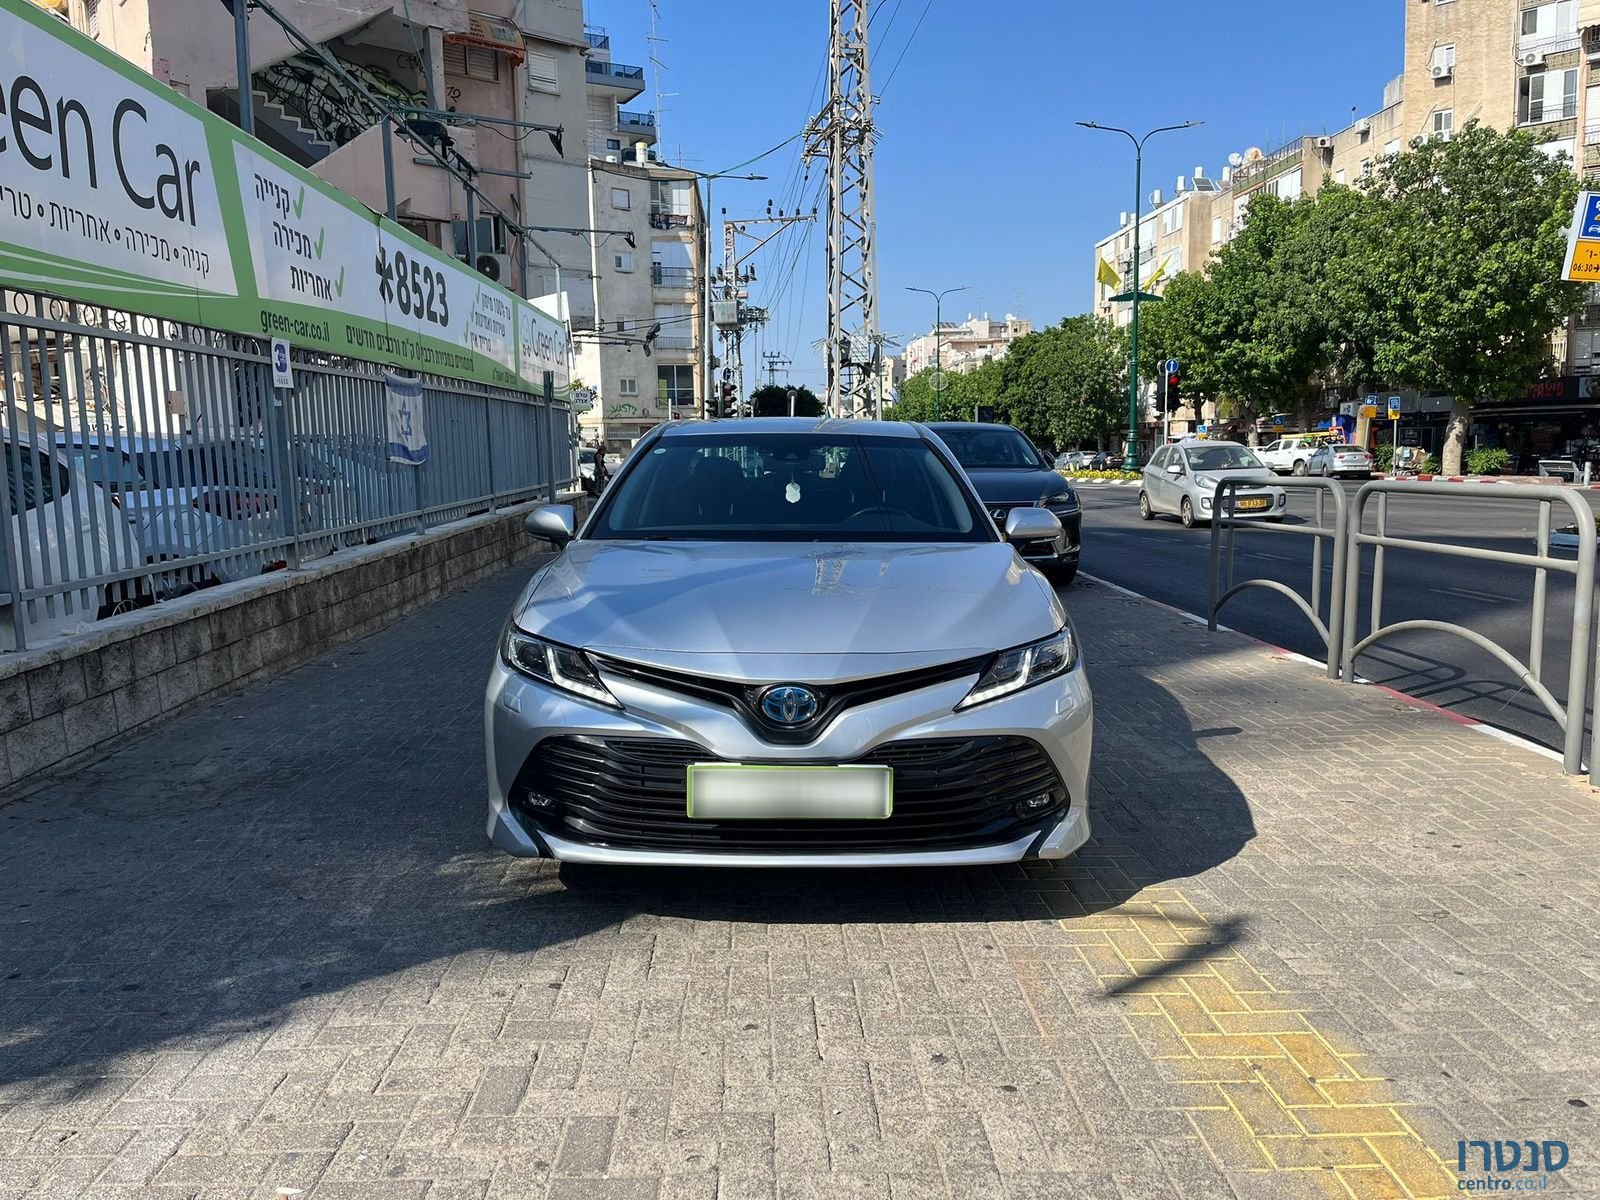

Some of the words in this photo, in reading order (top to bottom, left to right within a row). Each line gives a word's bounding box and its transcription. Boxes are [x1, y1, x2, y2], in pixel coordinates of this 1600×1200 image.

[113, 98, 200, 227] Car
[254, 173, 290, 220] קנייה
[49, 201, 111, 244] אחריות
[272, 221, 312, 259] מכירה
[125, 226, 171, 261] מכירה
[182, 246, 210, 279] קניה
[290, 265, 333, 301] אחריות
[260, 310, 330, 342] green-car.co.il
[345, 323, 375, 348] חדשים
[376, 332, 400, 356] ורכבים
[531, 318, 555, 362] Green
